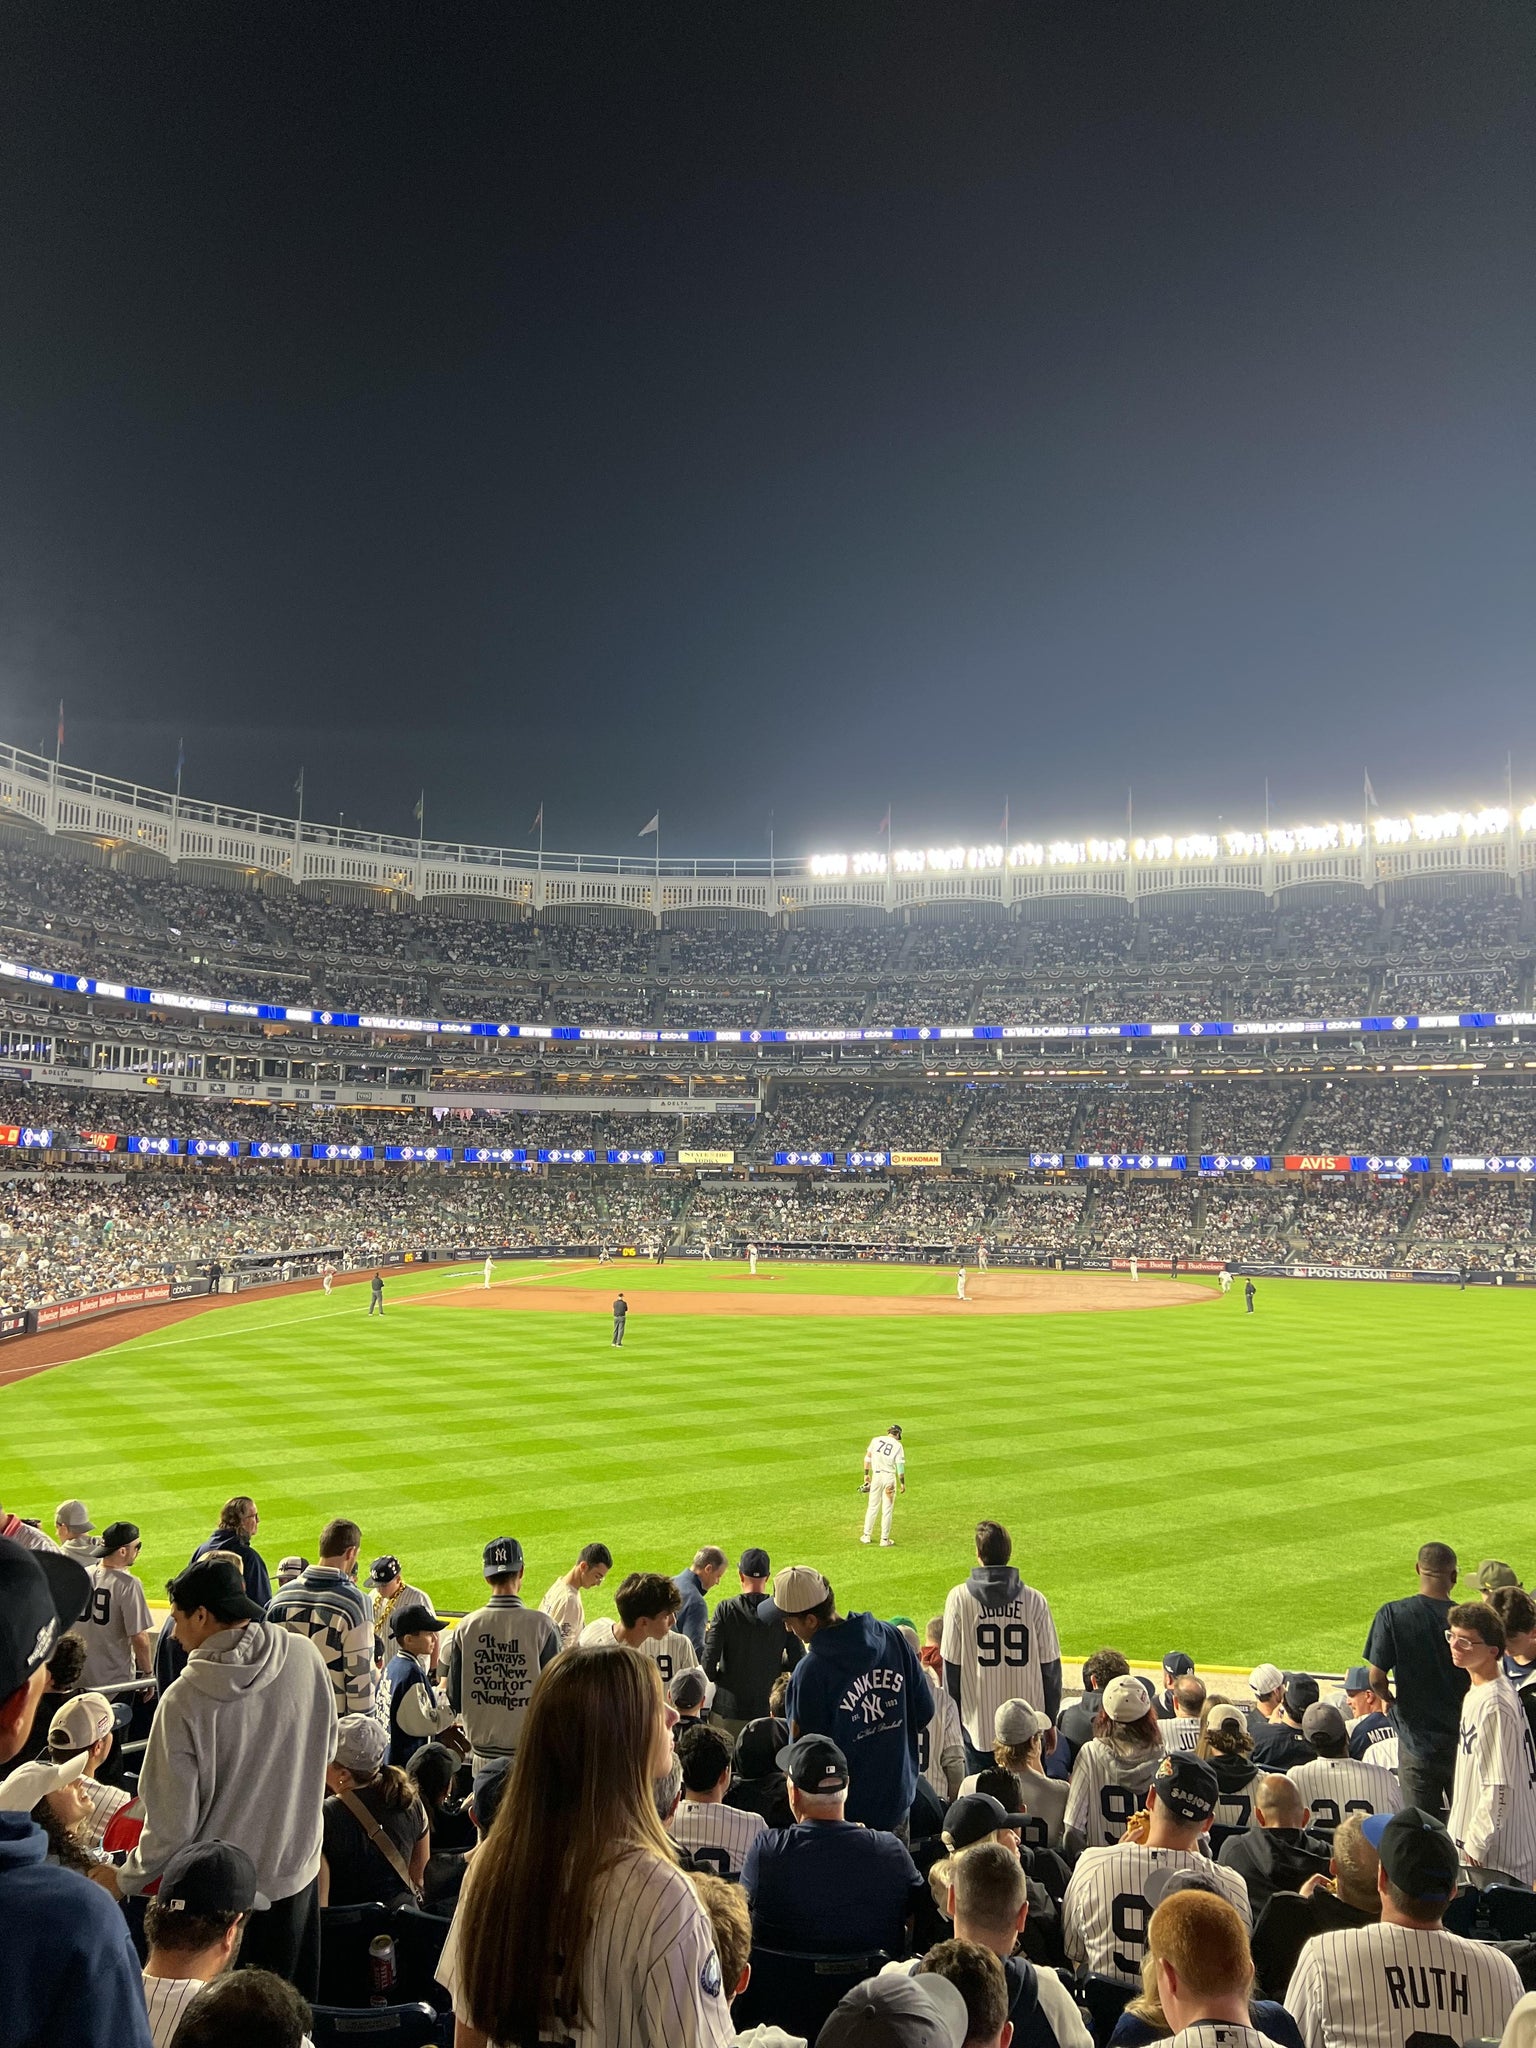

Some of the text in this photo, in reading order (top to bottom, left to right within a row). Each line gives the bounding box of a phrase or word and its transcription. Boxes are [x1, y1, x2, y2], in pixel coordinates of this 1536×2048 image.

[372, 1017, 398, 1029] WILD
[399, 1019, 423, 1031] CARD
[441, 1024, 472, 1033] abbvie
[1088, 1026, 1121, 1035] abbvie
[1247, 1023, 1277, 1033] WILD
[1277, 1022, 1304, 1032] CARD
[1326, 1021, 1362, 1030] abbvie
[592, 1029, 618, 1039] WILD
[618, 1030, 641, 1040] CARD
[660, 1032, 689, 1040] abbvie
[799, 1031, 823, 1040] WILD
[823, 1031, 845, 1040] CARD
[863, 1030, 893, 1038] abbvie
[1015, 1027, 1043, 1037] WILD
[1043, 1026, 1068, 1036] CARD
[393, 1053, 432, 1062] Champions
[48, 1069, 69, 1077] DELTA
[1300, 1157, 1336, 1170] AVIS
[1188, 1261, 1225, 1270] Budweiser
[1308, 1267, 1389, 1280] POSTSEASON
[145, 1287, 170, 1299] Budweiser
[172, 1284, 192, 1295] abbvie
[116, 1290, 144, 1303] Budweiser
[878, 1440, 894, 1456] 78
[979, 1601, 1024, 1620] JUDGE
[478, 1634, 519, 1653] It will
[977, 1623, 1030, 1668] 99
[474, 1650, 527, 1667] Always
[474, 1662, 528, 1680] be New
[473, 1677, 532, 1696] York or
[839, 1669, 904, 1712] YANKEES
[861, 1693, 886, 1724] NY
[1219, 1794, 1252, 1827] 7
[1384, 1965, 1469, 2016] RUTH
